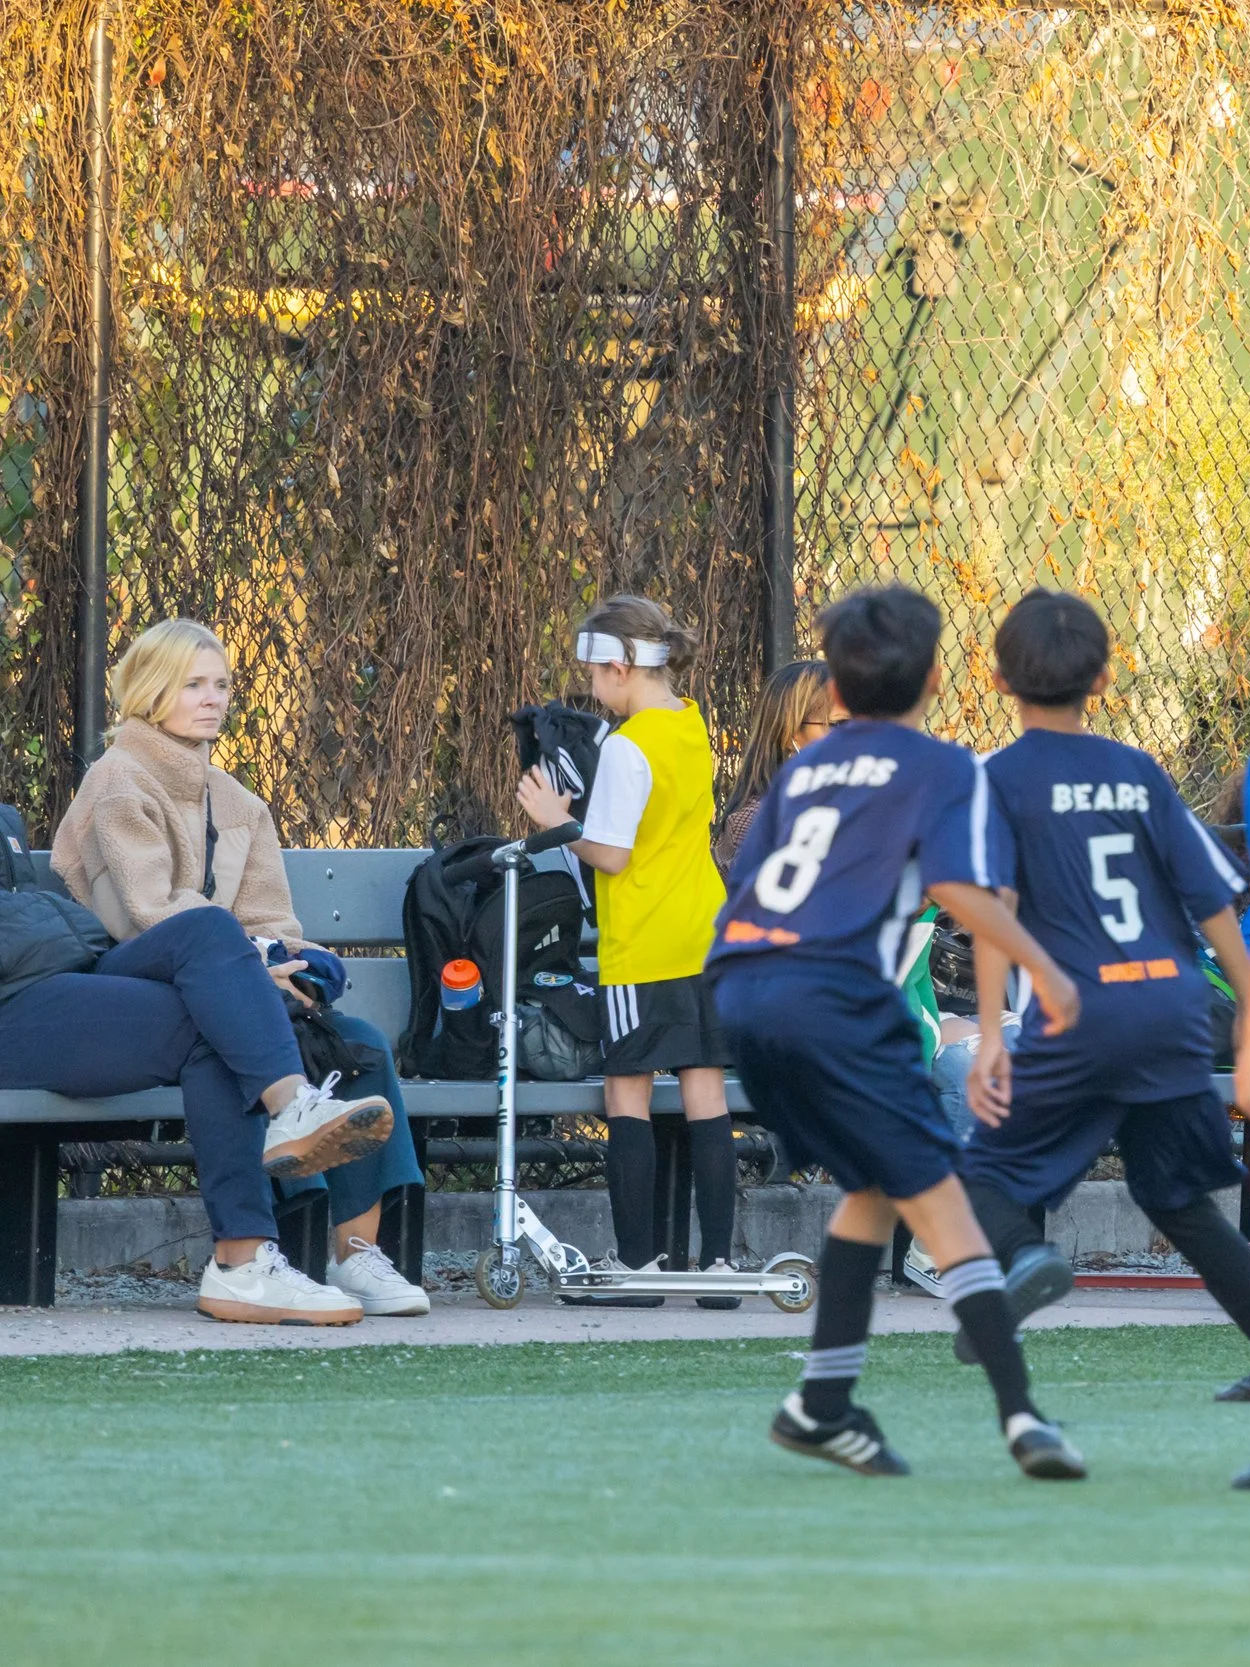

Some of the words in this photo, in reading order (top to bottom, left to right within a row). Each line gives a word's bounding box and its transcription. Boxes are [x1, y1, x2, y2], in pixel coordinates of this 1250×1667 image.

[1051, 783, 1150, 813] BEARS
[755, 806, 840, 914] 8
[1088, 833, 1144, 943] 5
